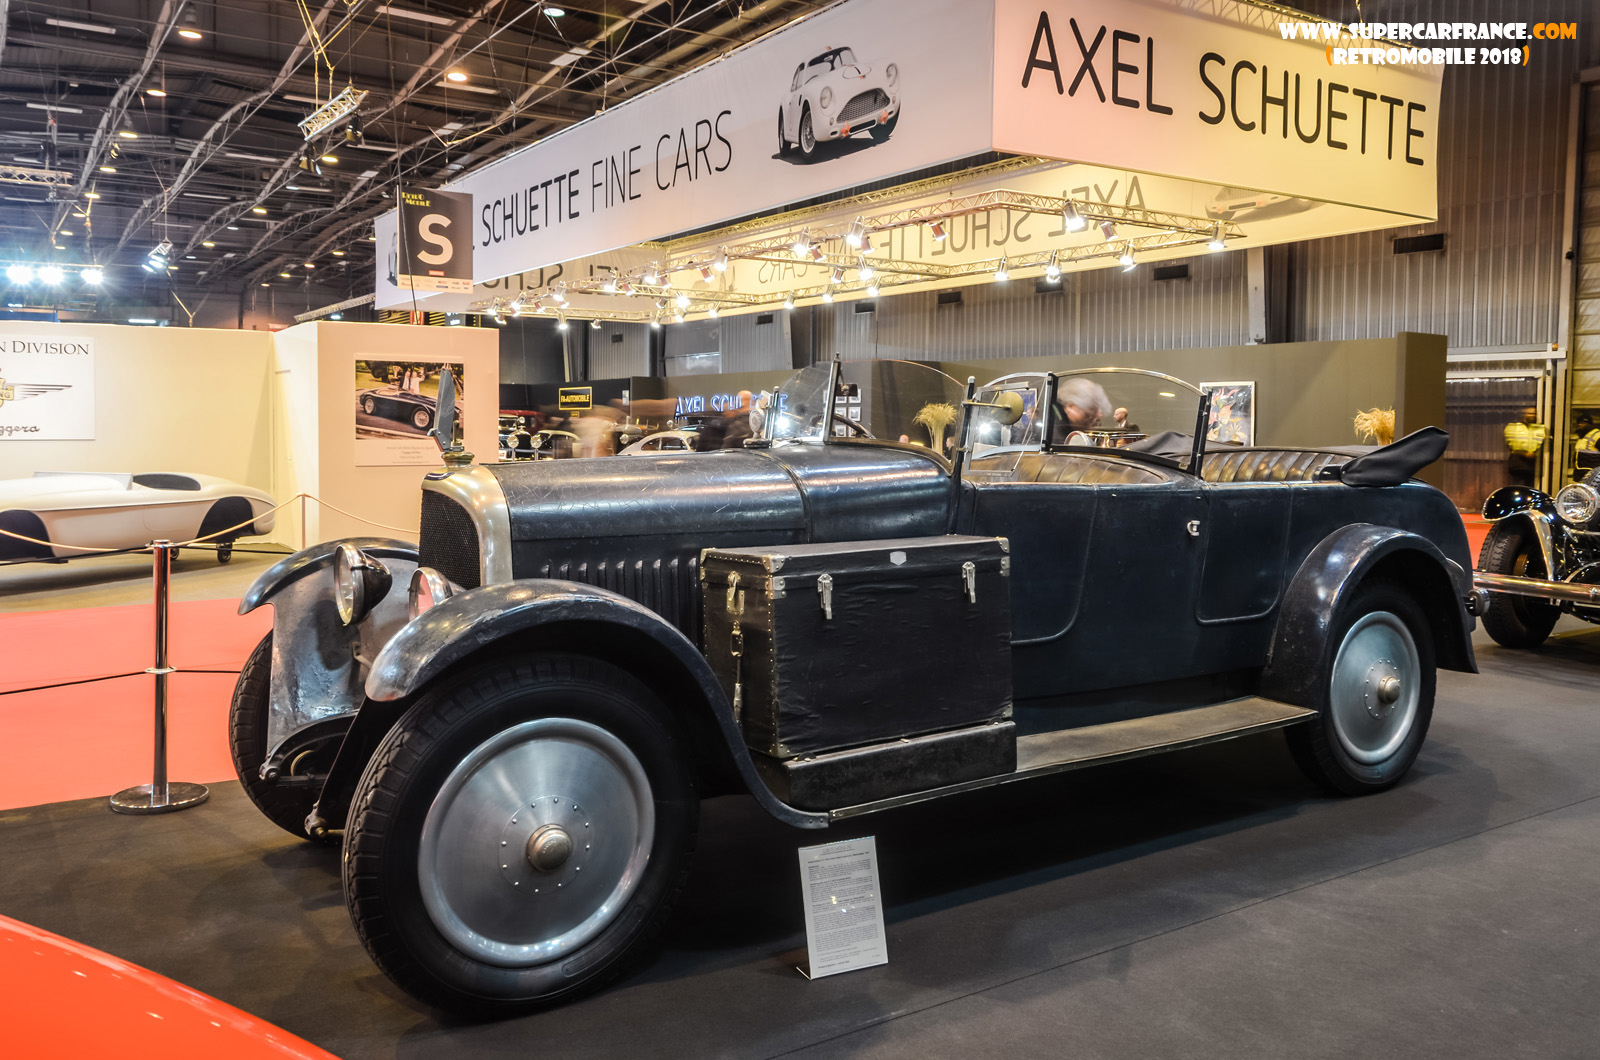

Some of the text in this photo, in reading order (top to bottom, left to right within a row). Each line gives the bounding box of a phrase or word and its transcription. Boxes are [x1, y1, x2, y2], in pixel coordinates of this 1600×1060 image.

[1021, 10, 1426, 166] AXEL SCHUETTE
[417, 214, 453, 265] S
[482, 109, 733, 246] SCHUETTE FINE CARS
